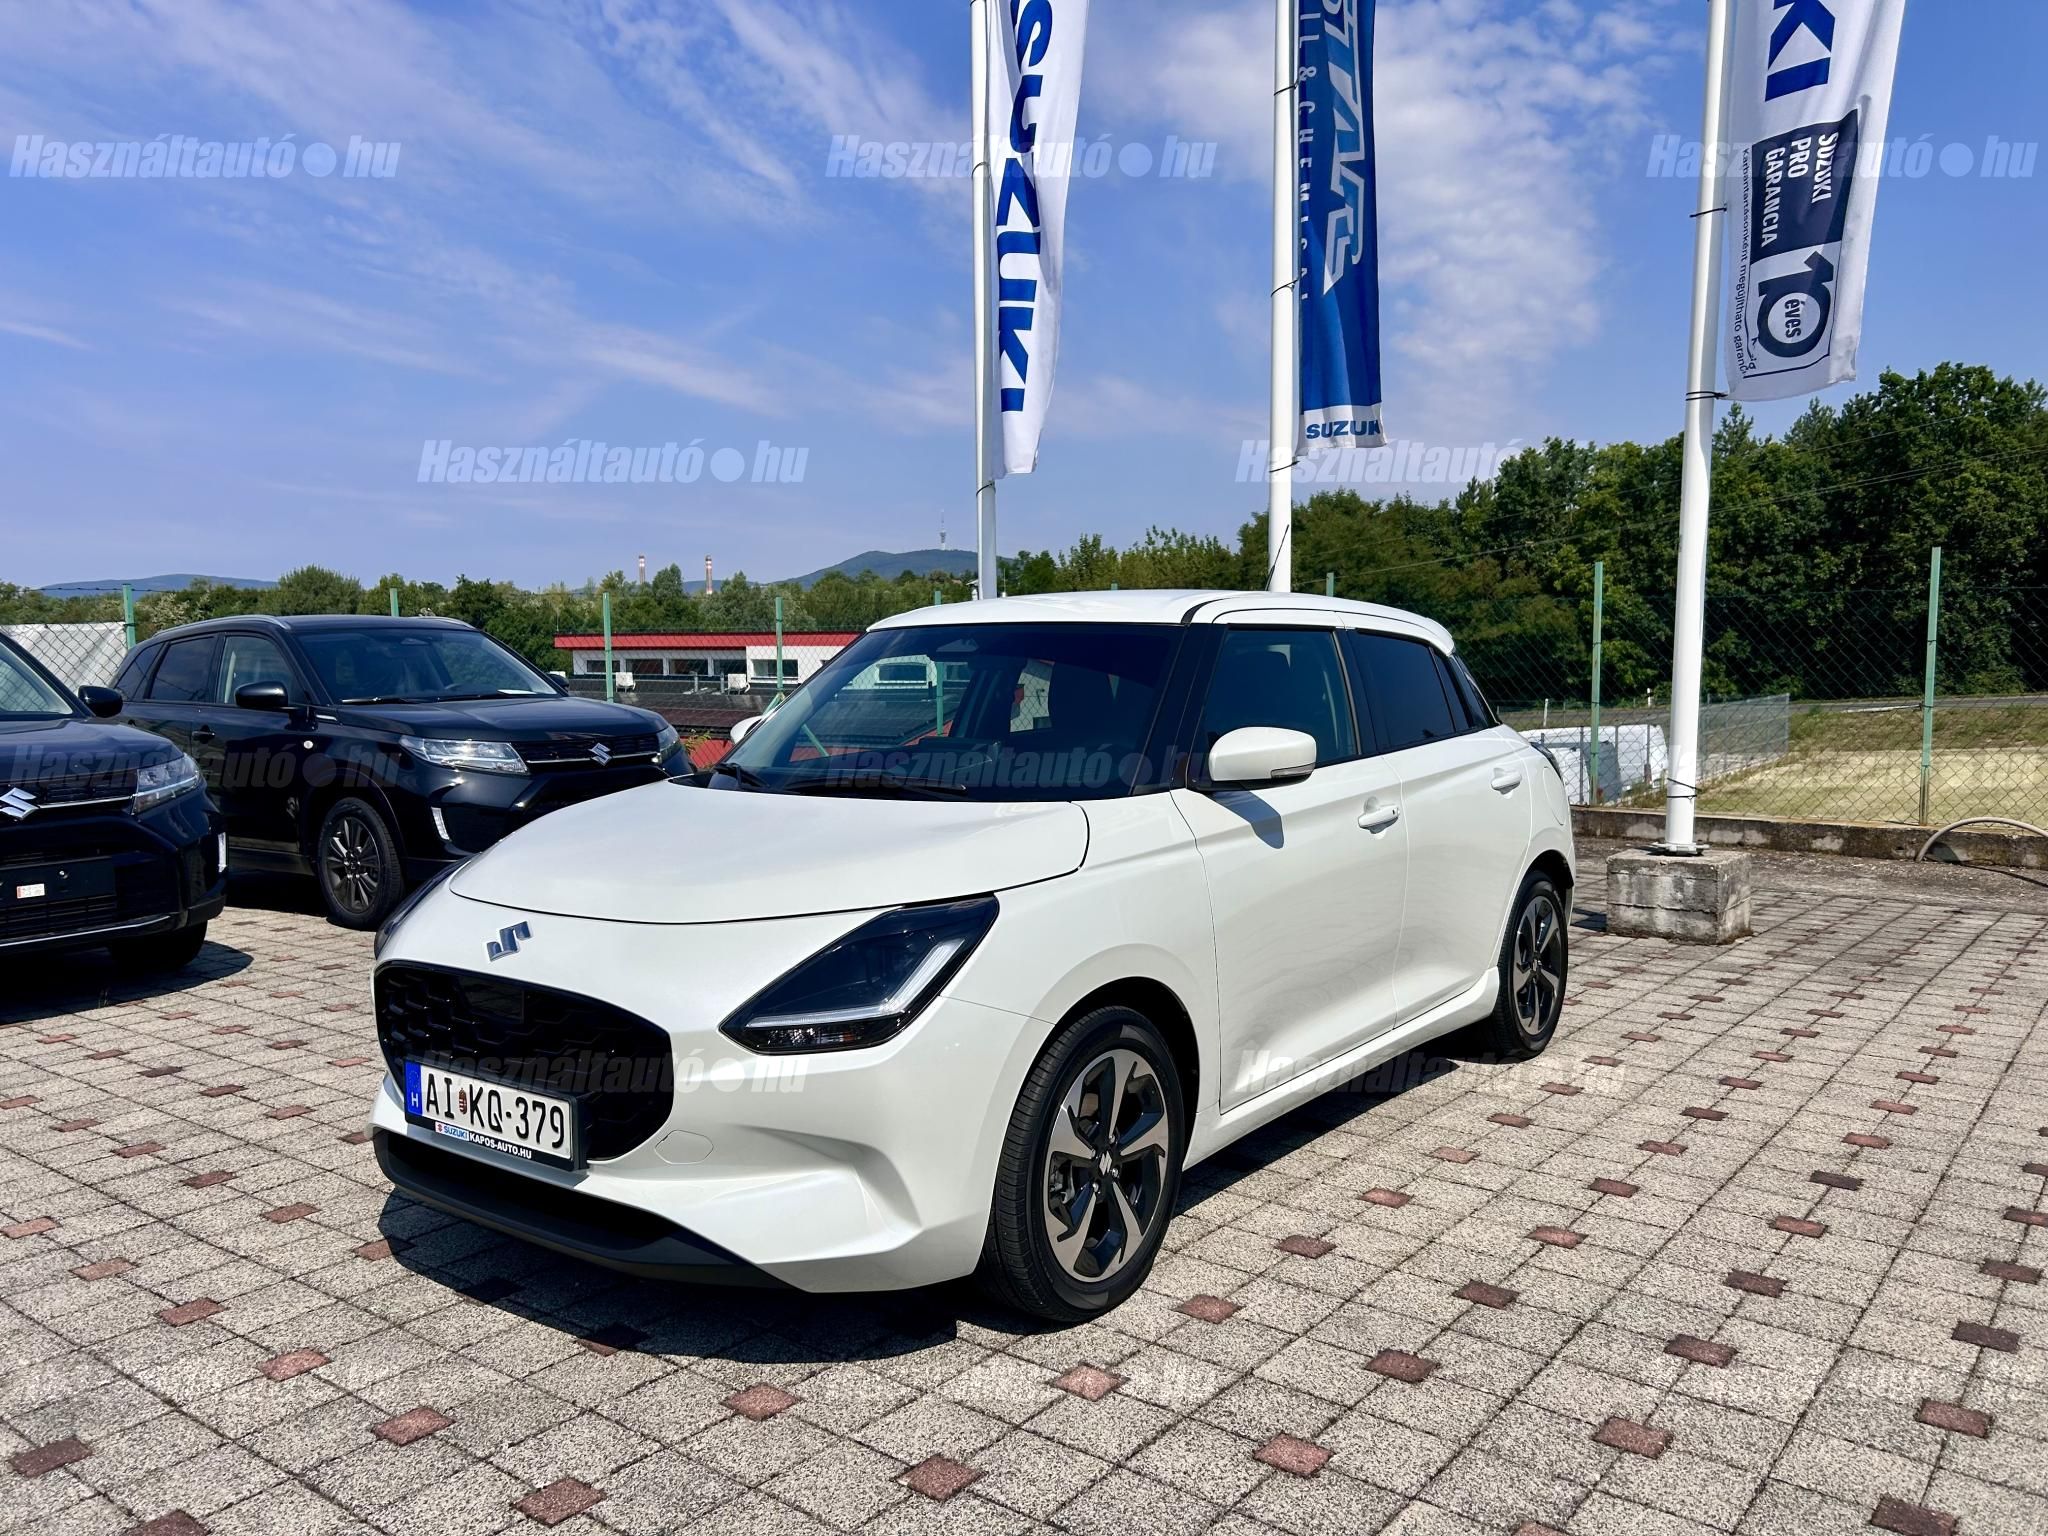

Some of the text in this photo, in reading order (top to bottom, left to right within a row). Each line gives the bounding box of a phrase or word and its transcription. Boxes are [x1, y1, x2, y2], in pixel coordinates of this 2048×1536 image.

[1787, 136, 1812, 179] PRO
[1811, 132, 1839, 204] SUZUKI
[995, 0, 1054, 413] SUZUKI
[1761, 147, 1786, 248] GARANCIA
[1757, 251, 1834, 358] 10
[1784, 299, 1806, 338] éves
[1305, 420, 1381, 440] SUZUK
[411, 1091, 420, 1109] H
[425, 1072, 565, 1149] AI KQ-379
[443, 1125, 533, 1160] SUZUKI KAPOS-AUTO.HU
